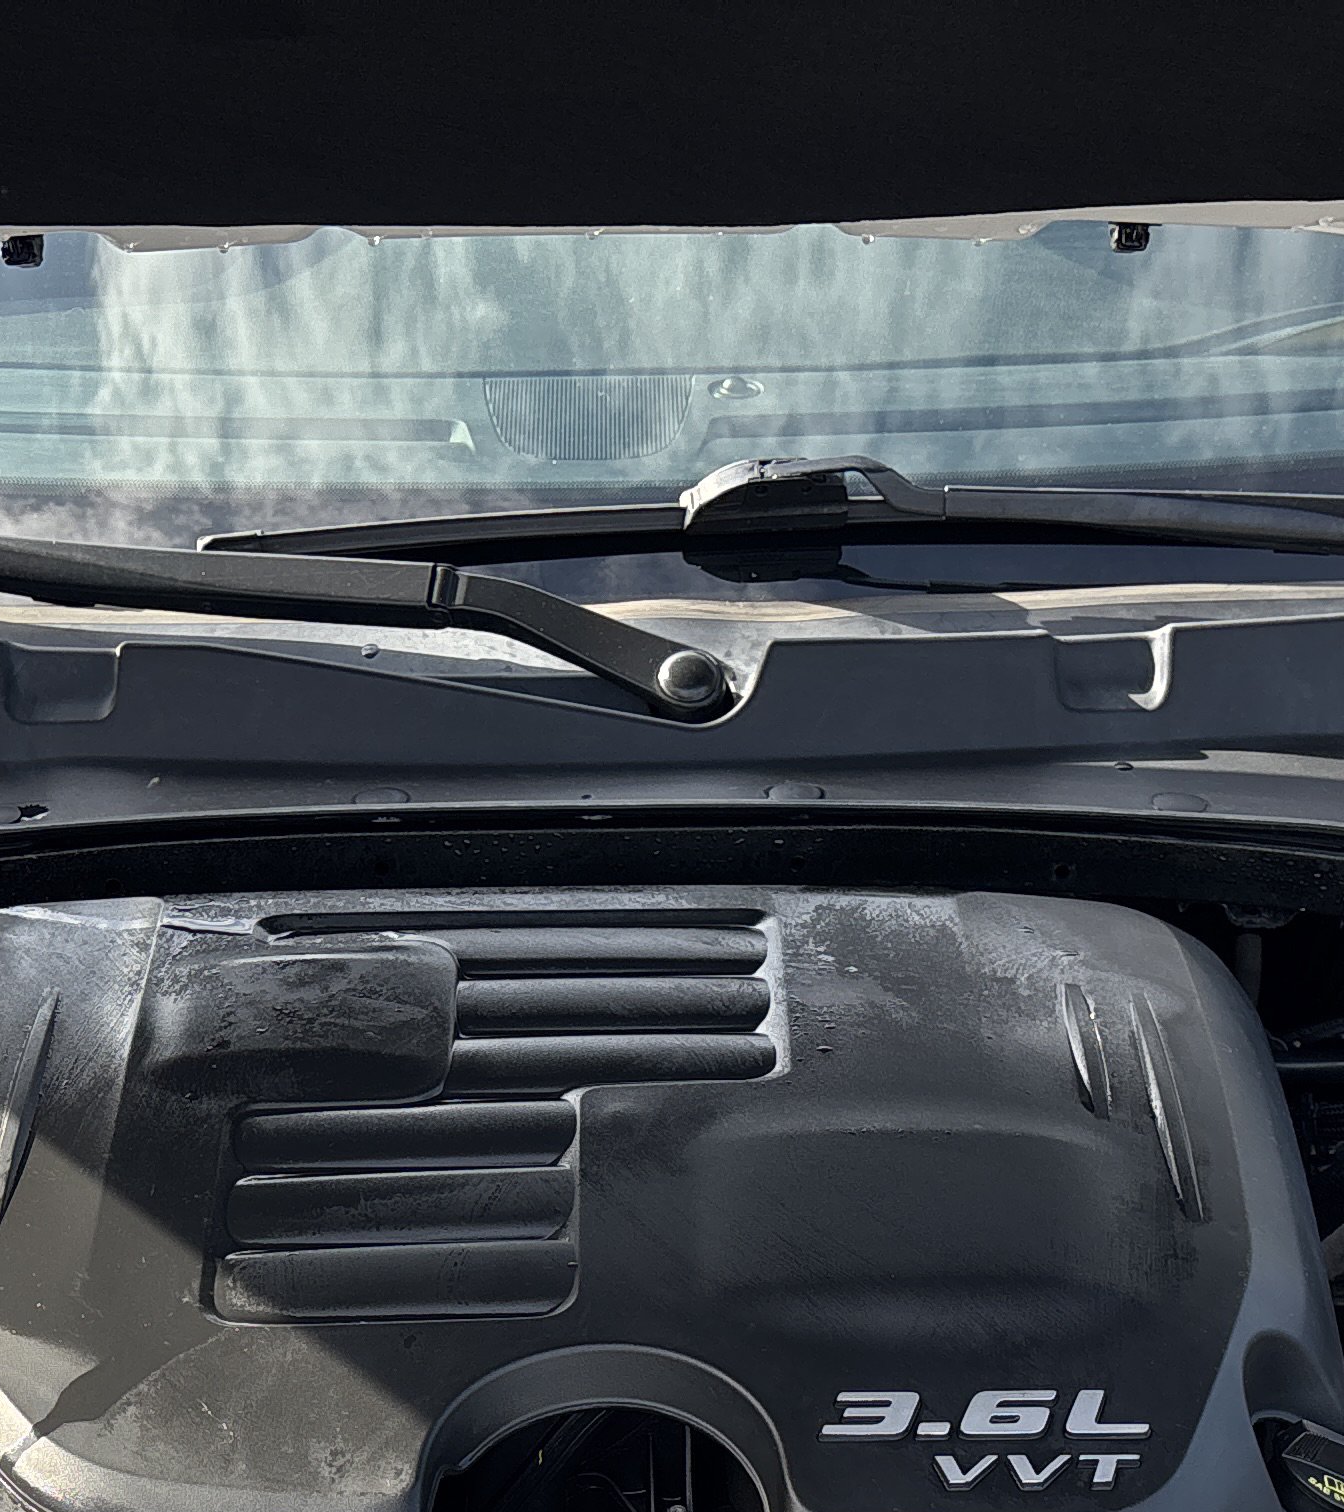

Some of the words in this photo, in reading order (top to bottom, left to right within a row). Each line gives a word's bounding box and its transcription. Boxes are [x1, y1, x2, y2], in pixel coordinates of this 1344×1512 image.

[818, 1389, 1151, 1439] 3.6L
[933, 1454, 1142, 1490] VVT
[1307, 1476, 1331, 1496] SAE
